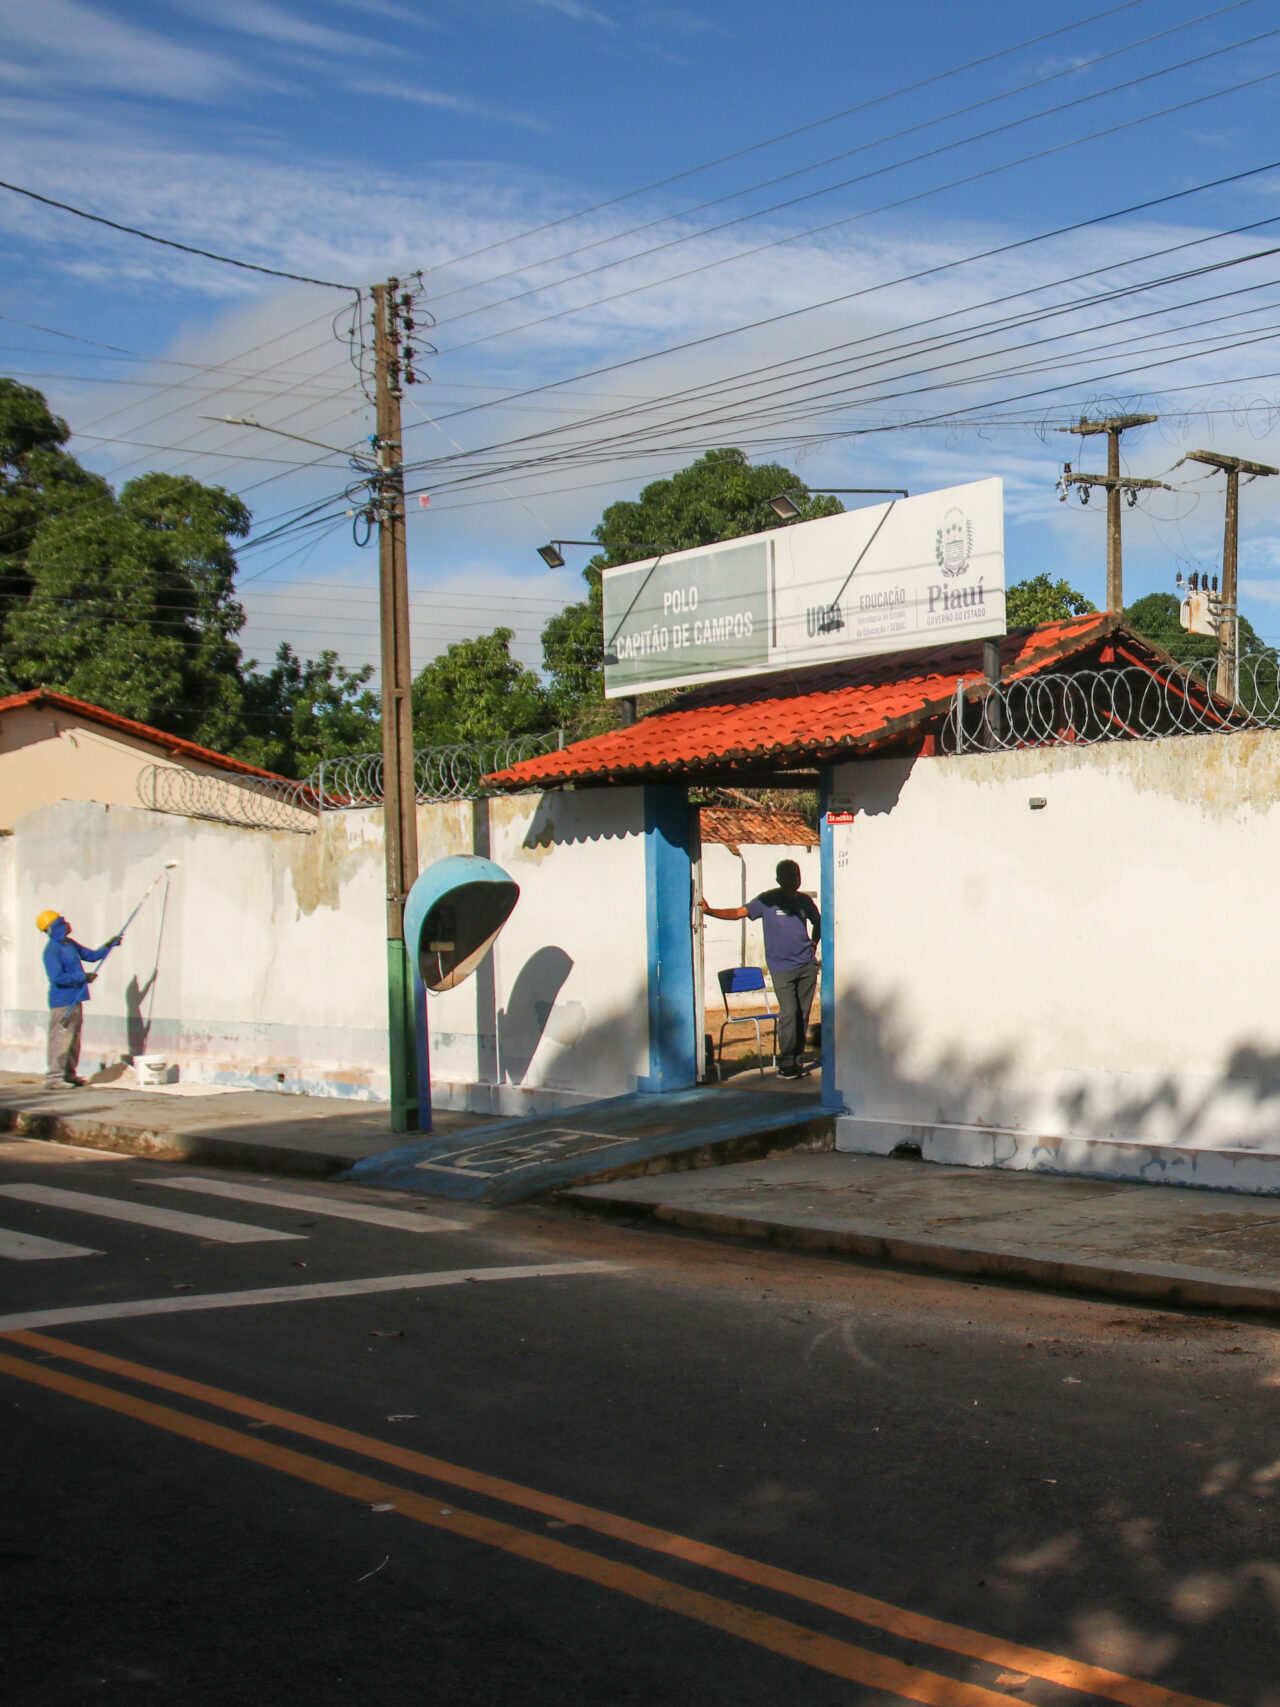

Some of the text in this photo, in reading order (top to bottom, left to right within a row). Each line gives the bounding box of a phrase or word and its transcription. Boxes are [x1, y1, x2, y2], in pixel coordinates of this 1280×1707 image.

[663, 586, 698, 616] POLO
[860, 586, 906, 611] EDUCAÇÃO
[927, 576, 984, 614] Piauí
[927, 608, 986, 626] GOVERNO DO ESTADO
[616, 612, 753, 659] CAPITÃO DE CAMPOS
